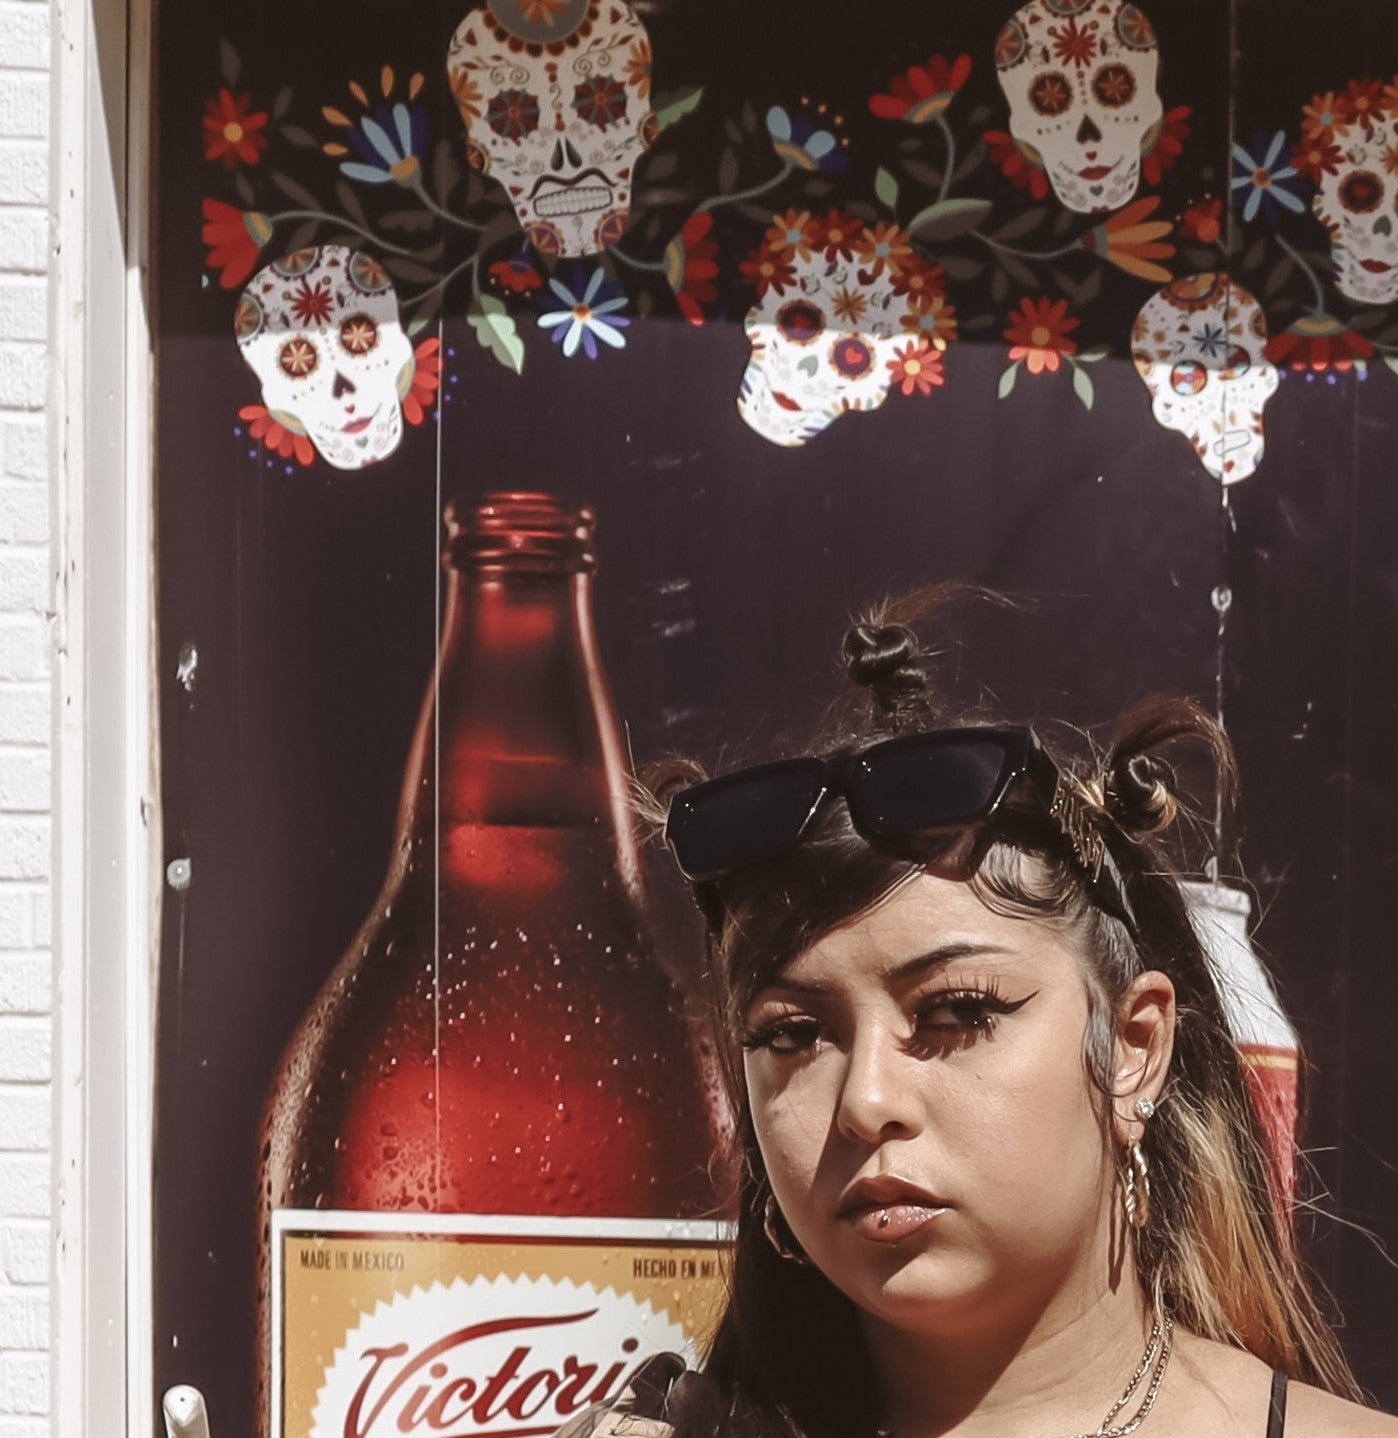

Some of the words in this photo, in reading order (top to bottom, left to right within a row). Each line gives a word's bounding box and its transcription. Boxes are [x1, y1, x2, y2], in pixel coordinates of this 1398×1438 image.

[300, 1249, 332, 1271] MADE
[335, 1250, 348, 1271] IN
[352, 1251, 405, 1272] MEXICO
[633, 1258, 677, 1279] HECHO
[681, 1260, 697, 1279] EN
